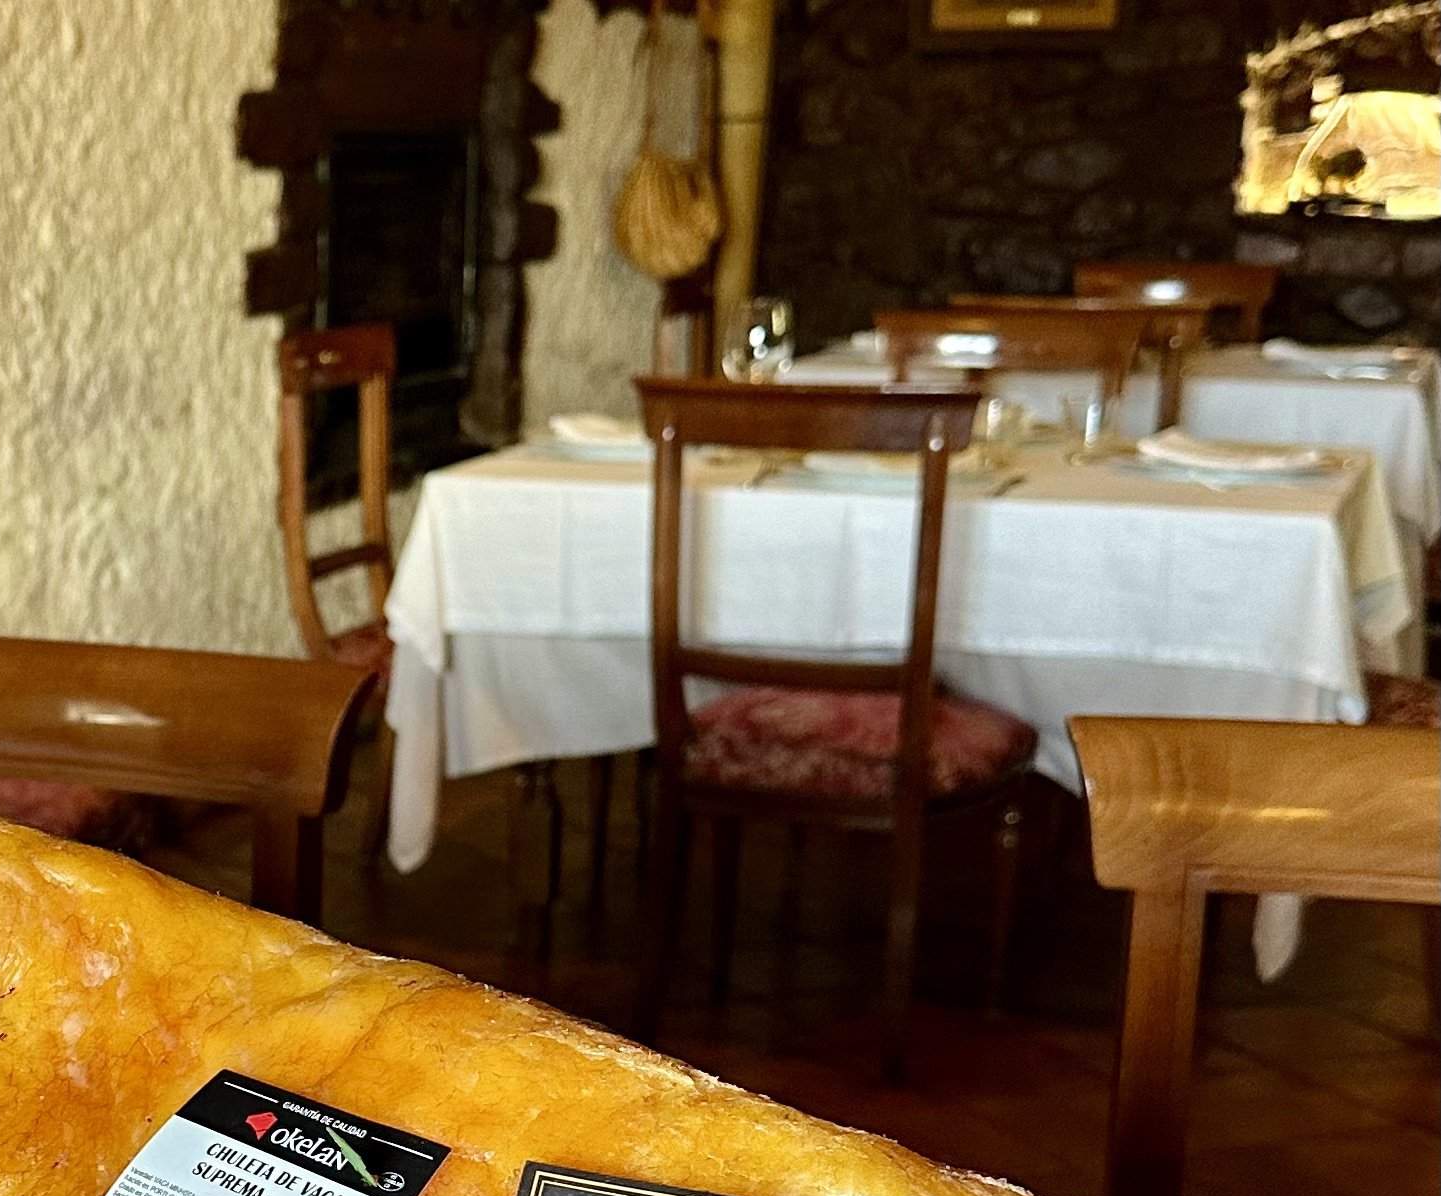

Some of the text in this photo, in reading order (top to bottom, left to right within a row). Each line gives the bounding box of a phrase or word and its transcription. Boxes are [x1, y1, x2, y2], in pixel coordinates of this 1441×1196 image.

[282, 1101, 368, 1139] GARANTÍA DE CALIDAD
[206, 1142, 276, 1181] CHULETA
[274, 1170, 303, 1192] DE
